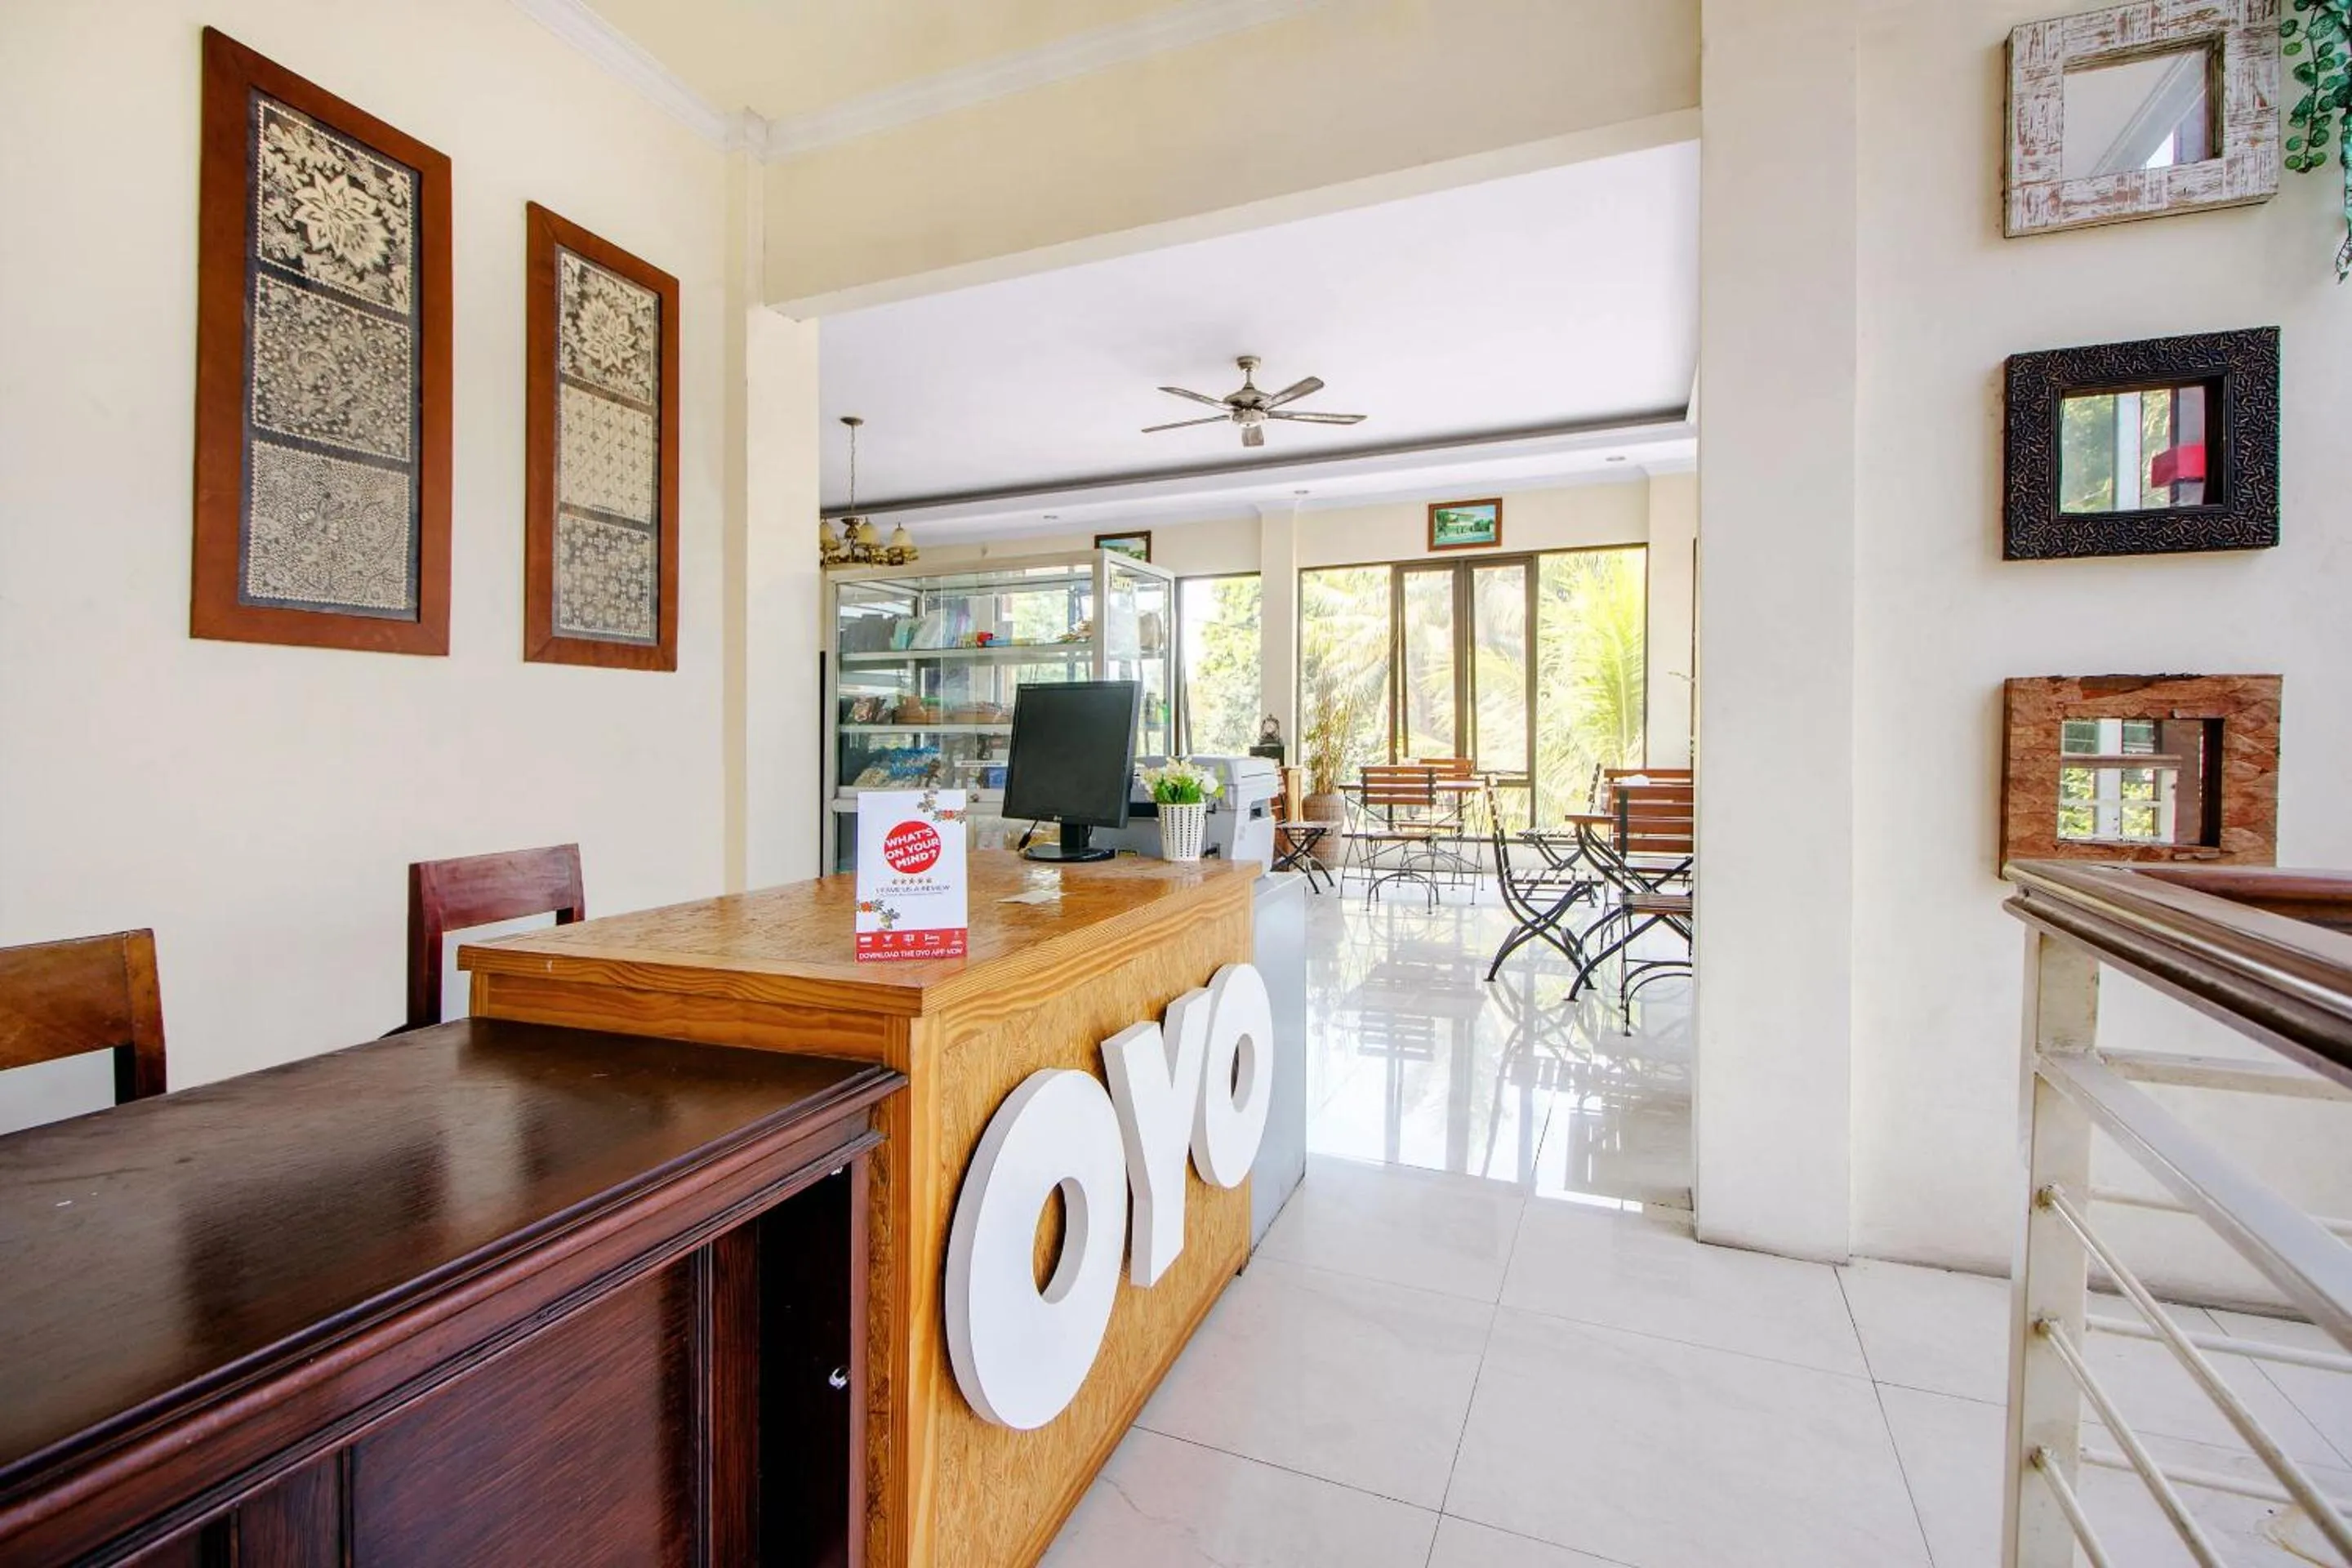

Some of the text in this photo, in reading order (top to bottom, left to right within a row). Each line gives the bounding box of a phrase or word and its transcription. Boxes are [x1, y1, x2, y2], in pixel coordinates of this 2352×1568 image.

[885, 827, 933, 847] WHAT'S
[886, 838, 939, 860] ON YOUR
[945, 963, 1274, 1431] OYO
